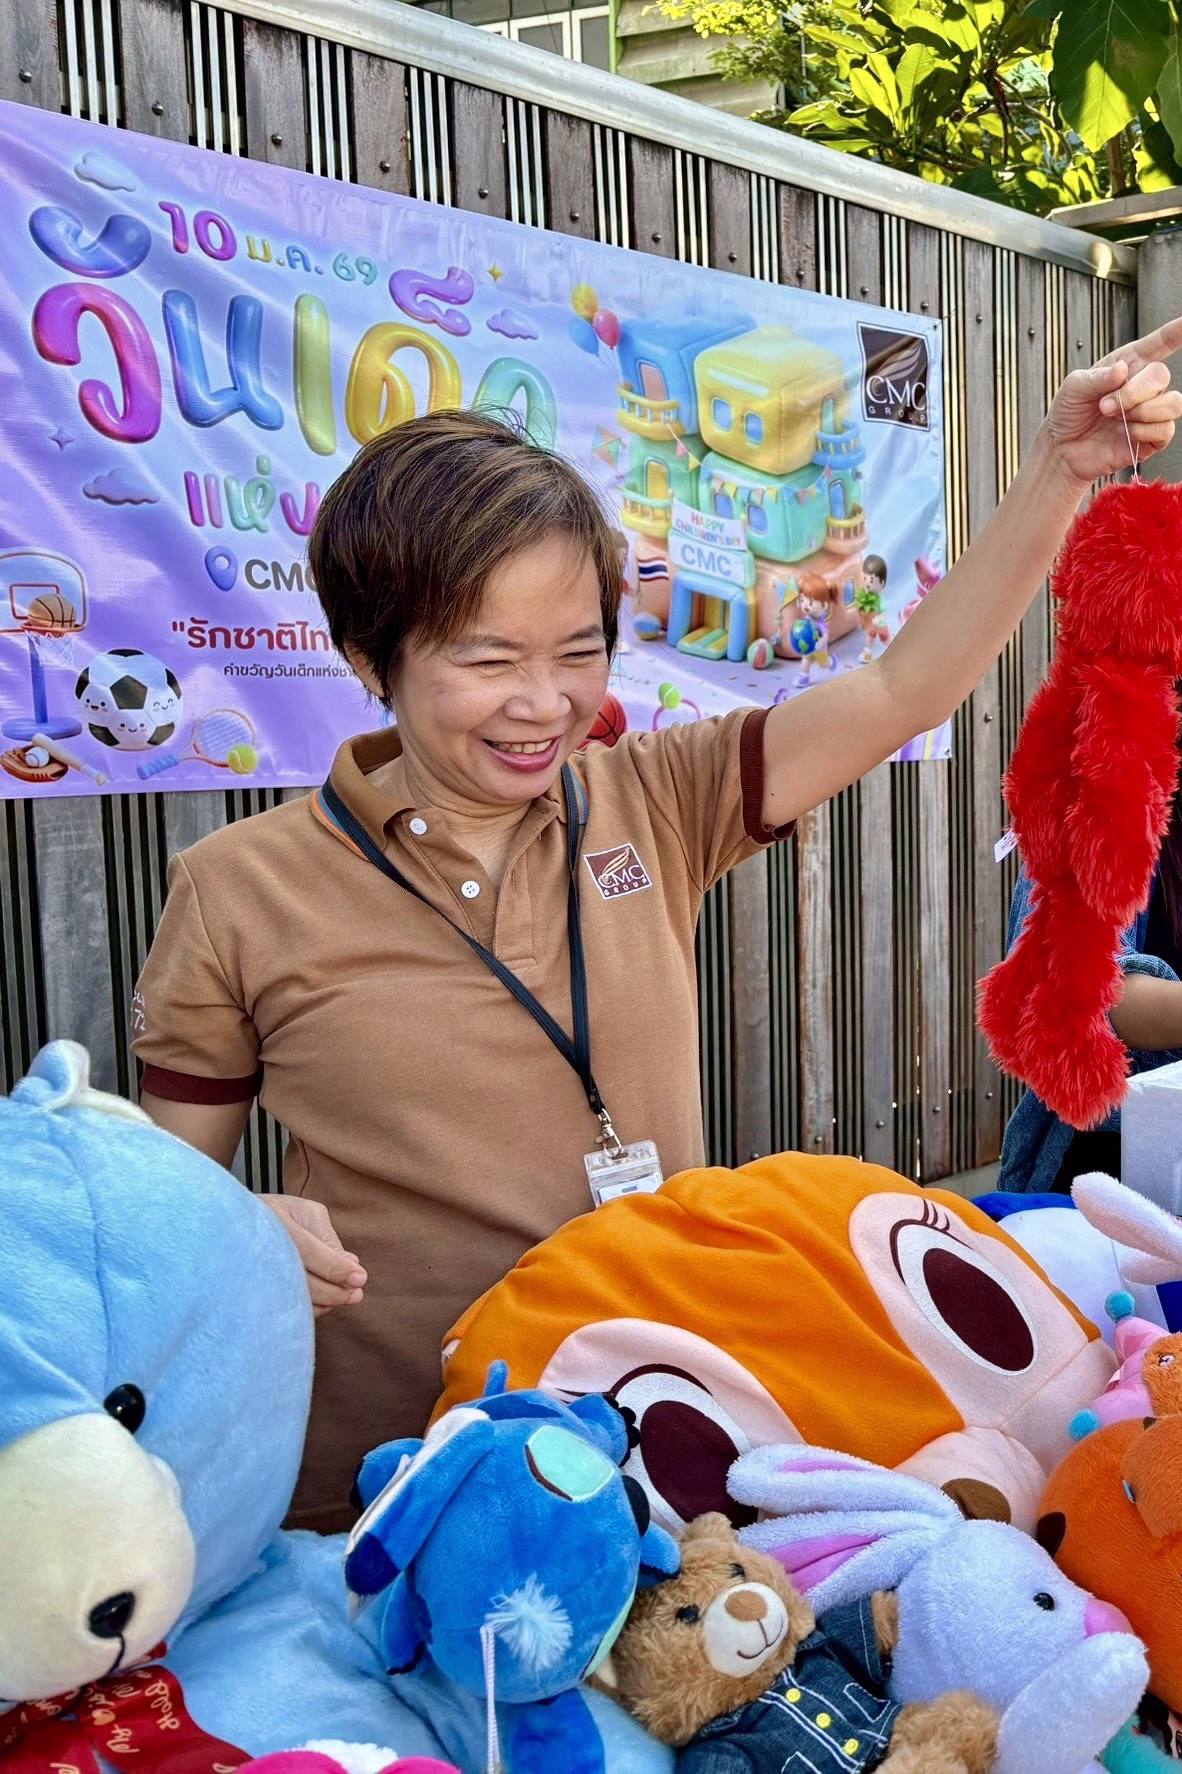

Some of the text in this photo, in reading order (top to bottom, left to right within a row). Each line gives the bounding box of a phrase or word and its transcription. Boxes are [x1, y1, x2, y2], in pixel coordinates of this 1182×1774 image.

[158, 201, 377, 286] 10 ม.ค. 69
[866, 375, 926, 411] CMC
[868, 405, 928, 425] GROUP
[680, 543, 731, 576] CMC
[172, 618, 337, 652] "รักชาติไท
[598, 864, 645, 889] CMC
[603, 877, 648, 896] GROUP
